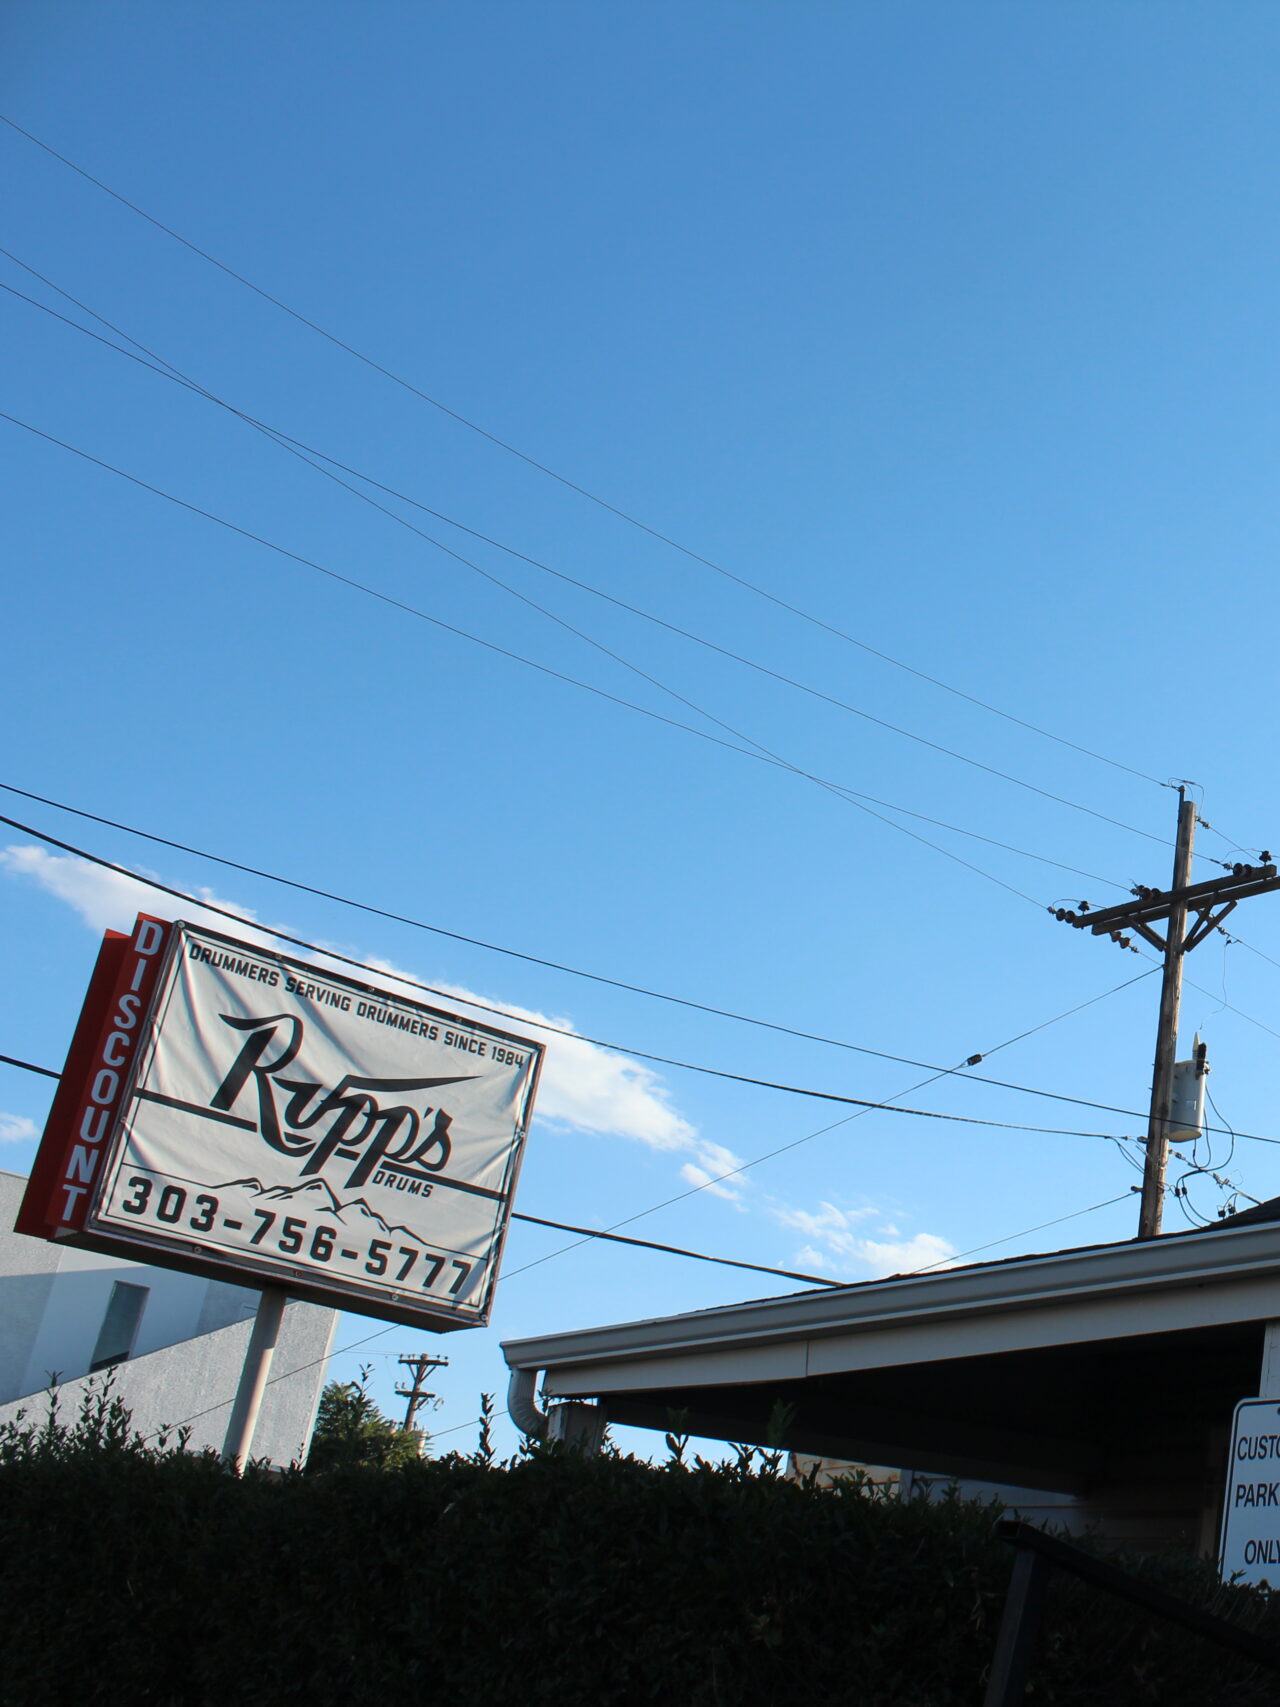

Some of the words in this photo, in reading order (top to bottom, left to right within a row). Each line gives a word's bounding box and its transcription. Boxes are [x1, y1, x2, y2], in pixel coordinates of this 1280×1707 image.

[189, 943, 279, 987] DRUMMERS
[285, 976, 352, 1012] SERVING
[356, 1001, 439, 1041] DRUMMERS
[443, 1030, 487, 1057] SINCE
[491, 1045, 524, 1069] 1984
[62, 920, 163, 1222] DISCOUNT
[209, 1013, 483, 1189] Rupp's
[122, 1175, 471, 1295] 303-756-5777
[372, 1170, 434, 1198] DRUMS
